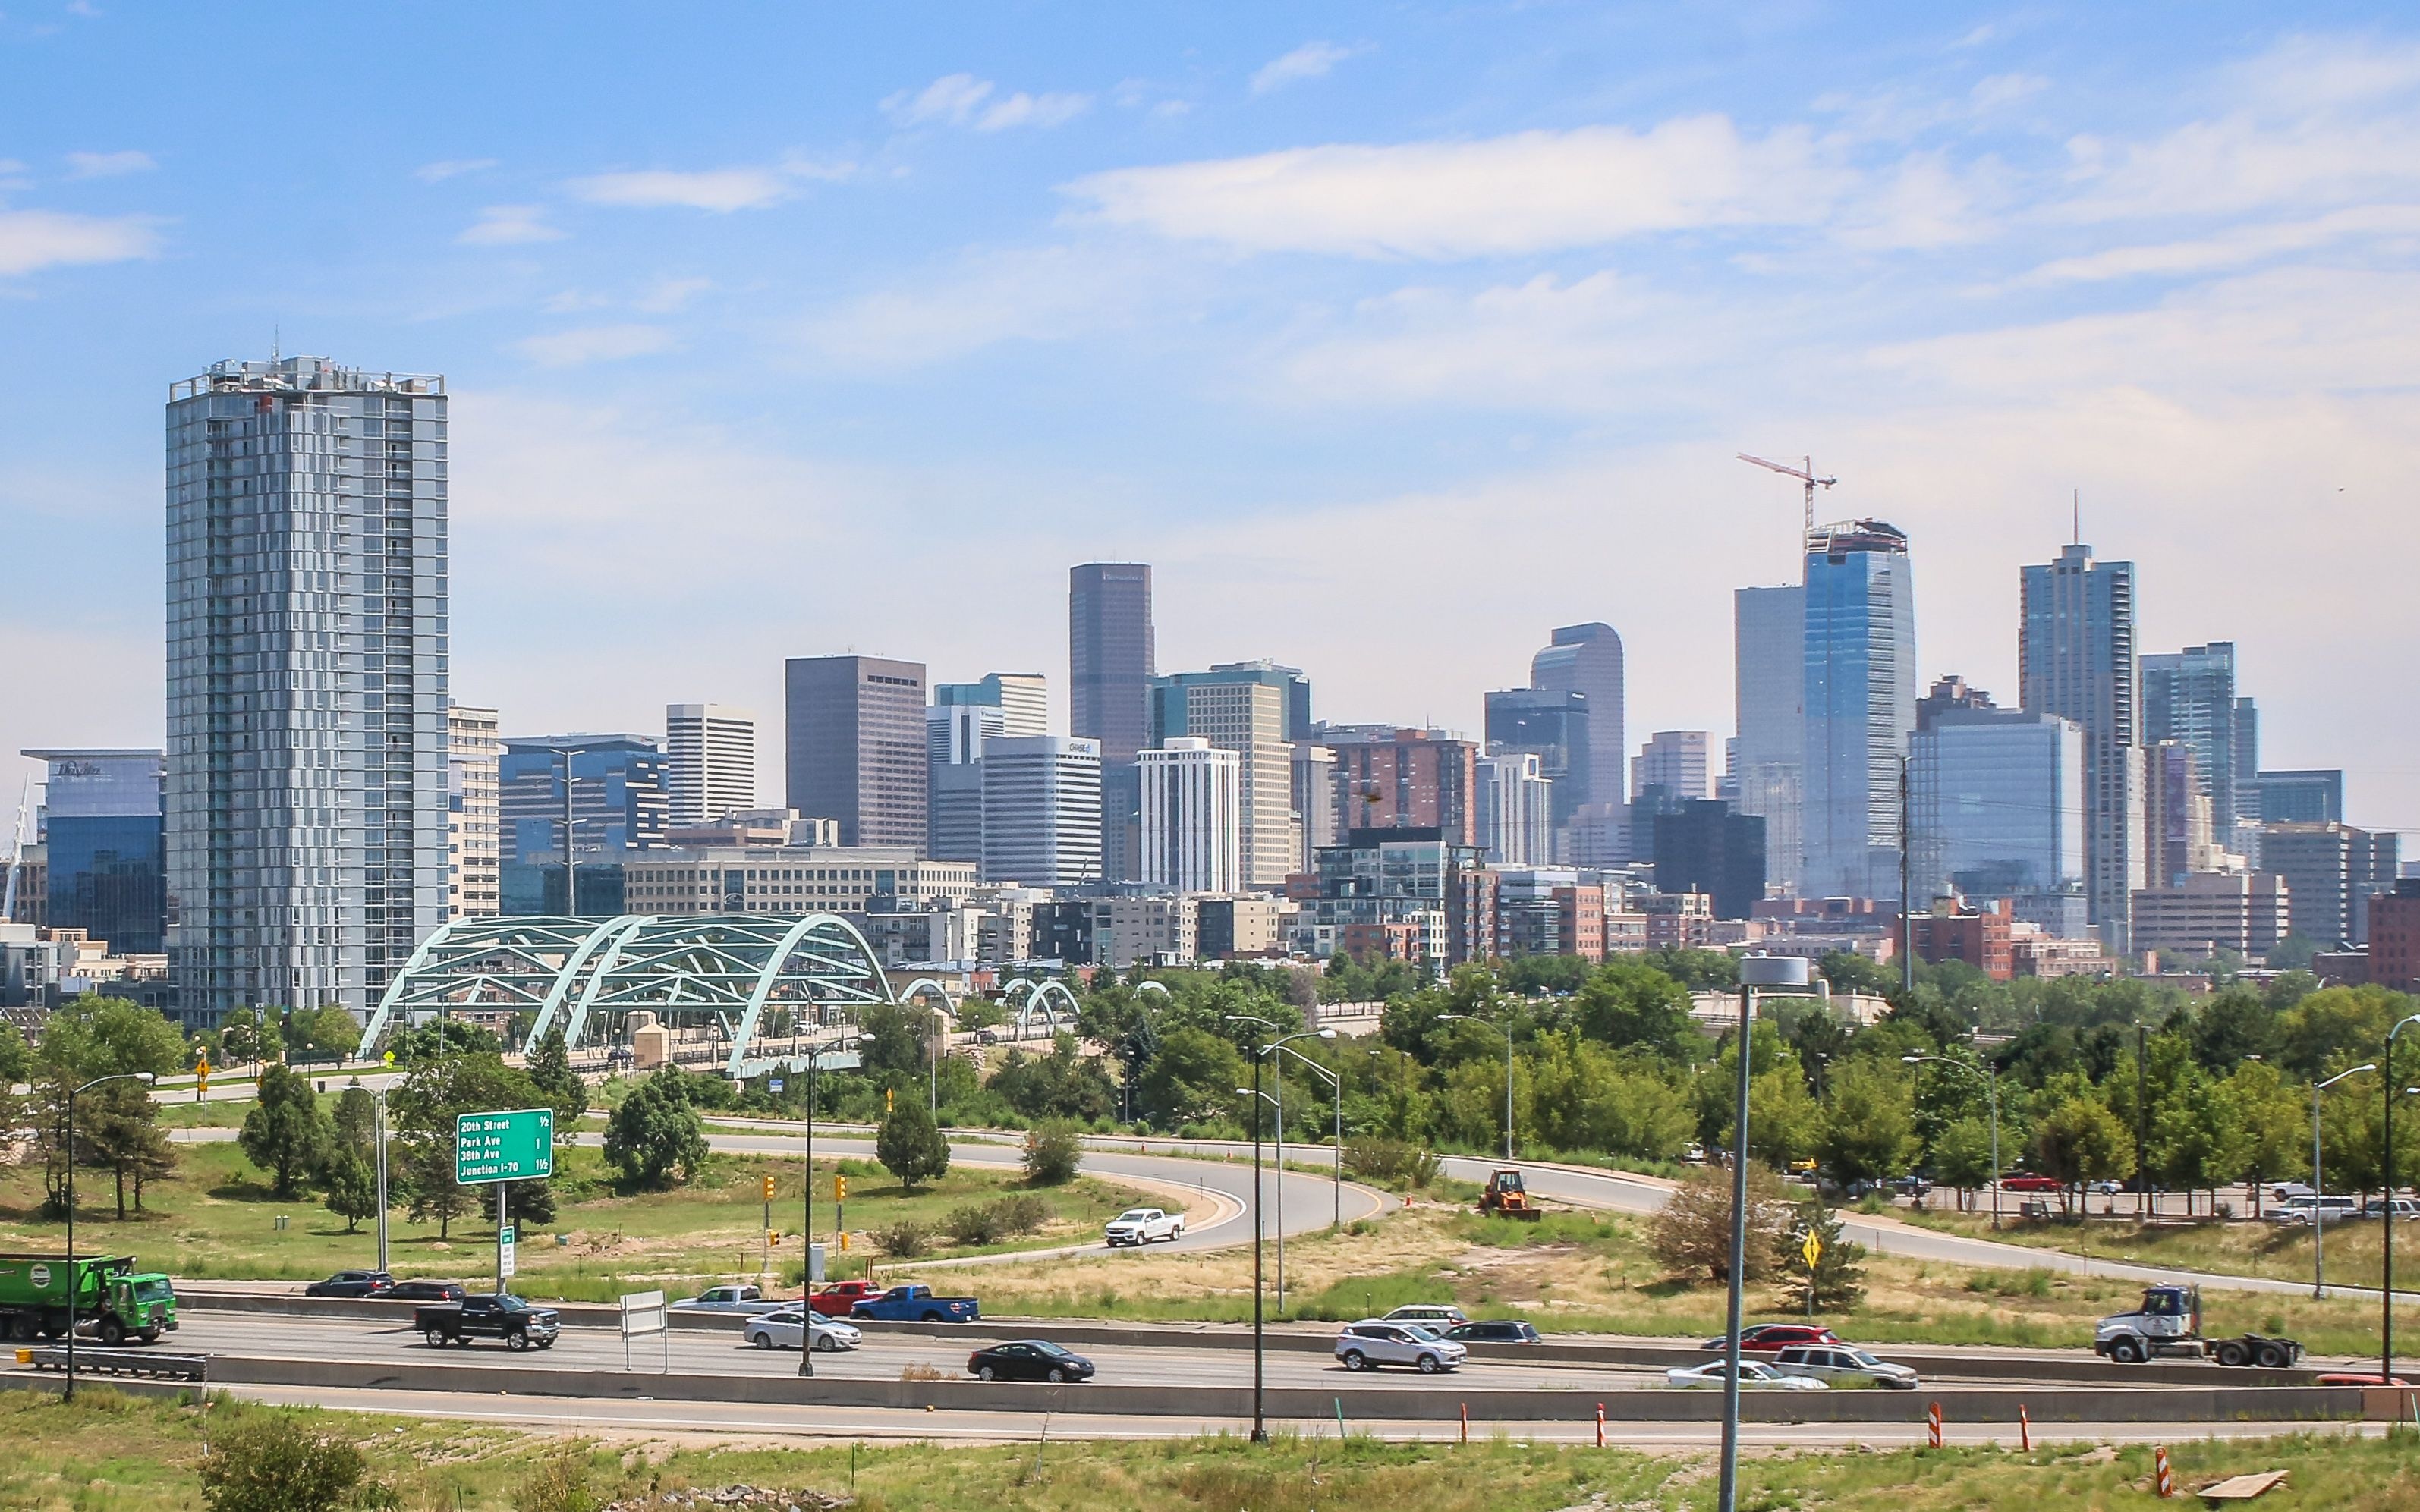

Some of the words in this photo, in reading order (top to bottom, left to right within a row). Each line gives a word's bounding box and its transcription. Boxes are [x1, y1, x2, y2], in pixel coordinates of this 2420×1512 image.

[461, 1121, 481, 1133] 20th
[483, 1119, 510, 1130] Street
[461, 1136, 481, 1148] Park
[484, 1136, 501, 1146] Ave
[536, 1138, 540, 1149] 1
[460, 1150, 480, 1162] 38th
[483, 1149, 500, 1160] Ave
[461, 1165, 498, 1176] Junction
[500, 1162, 519, 1173] I-70
